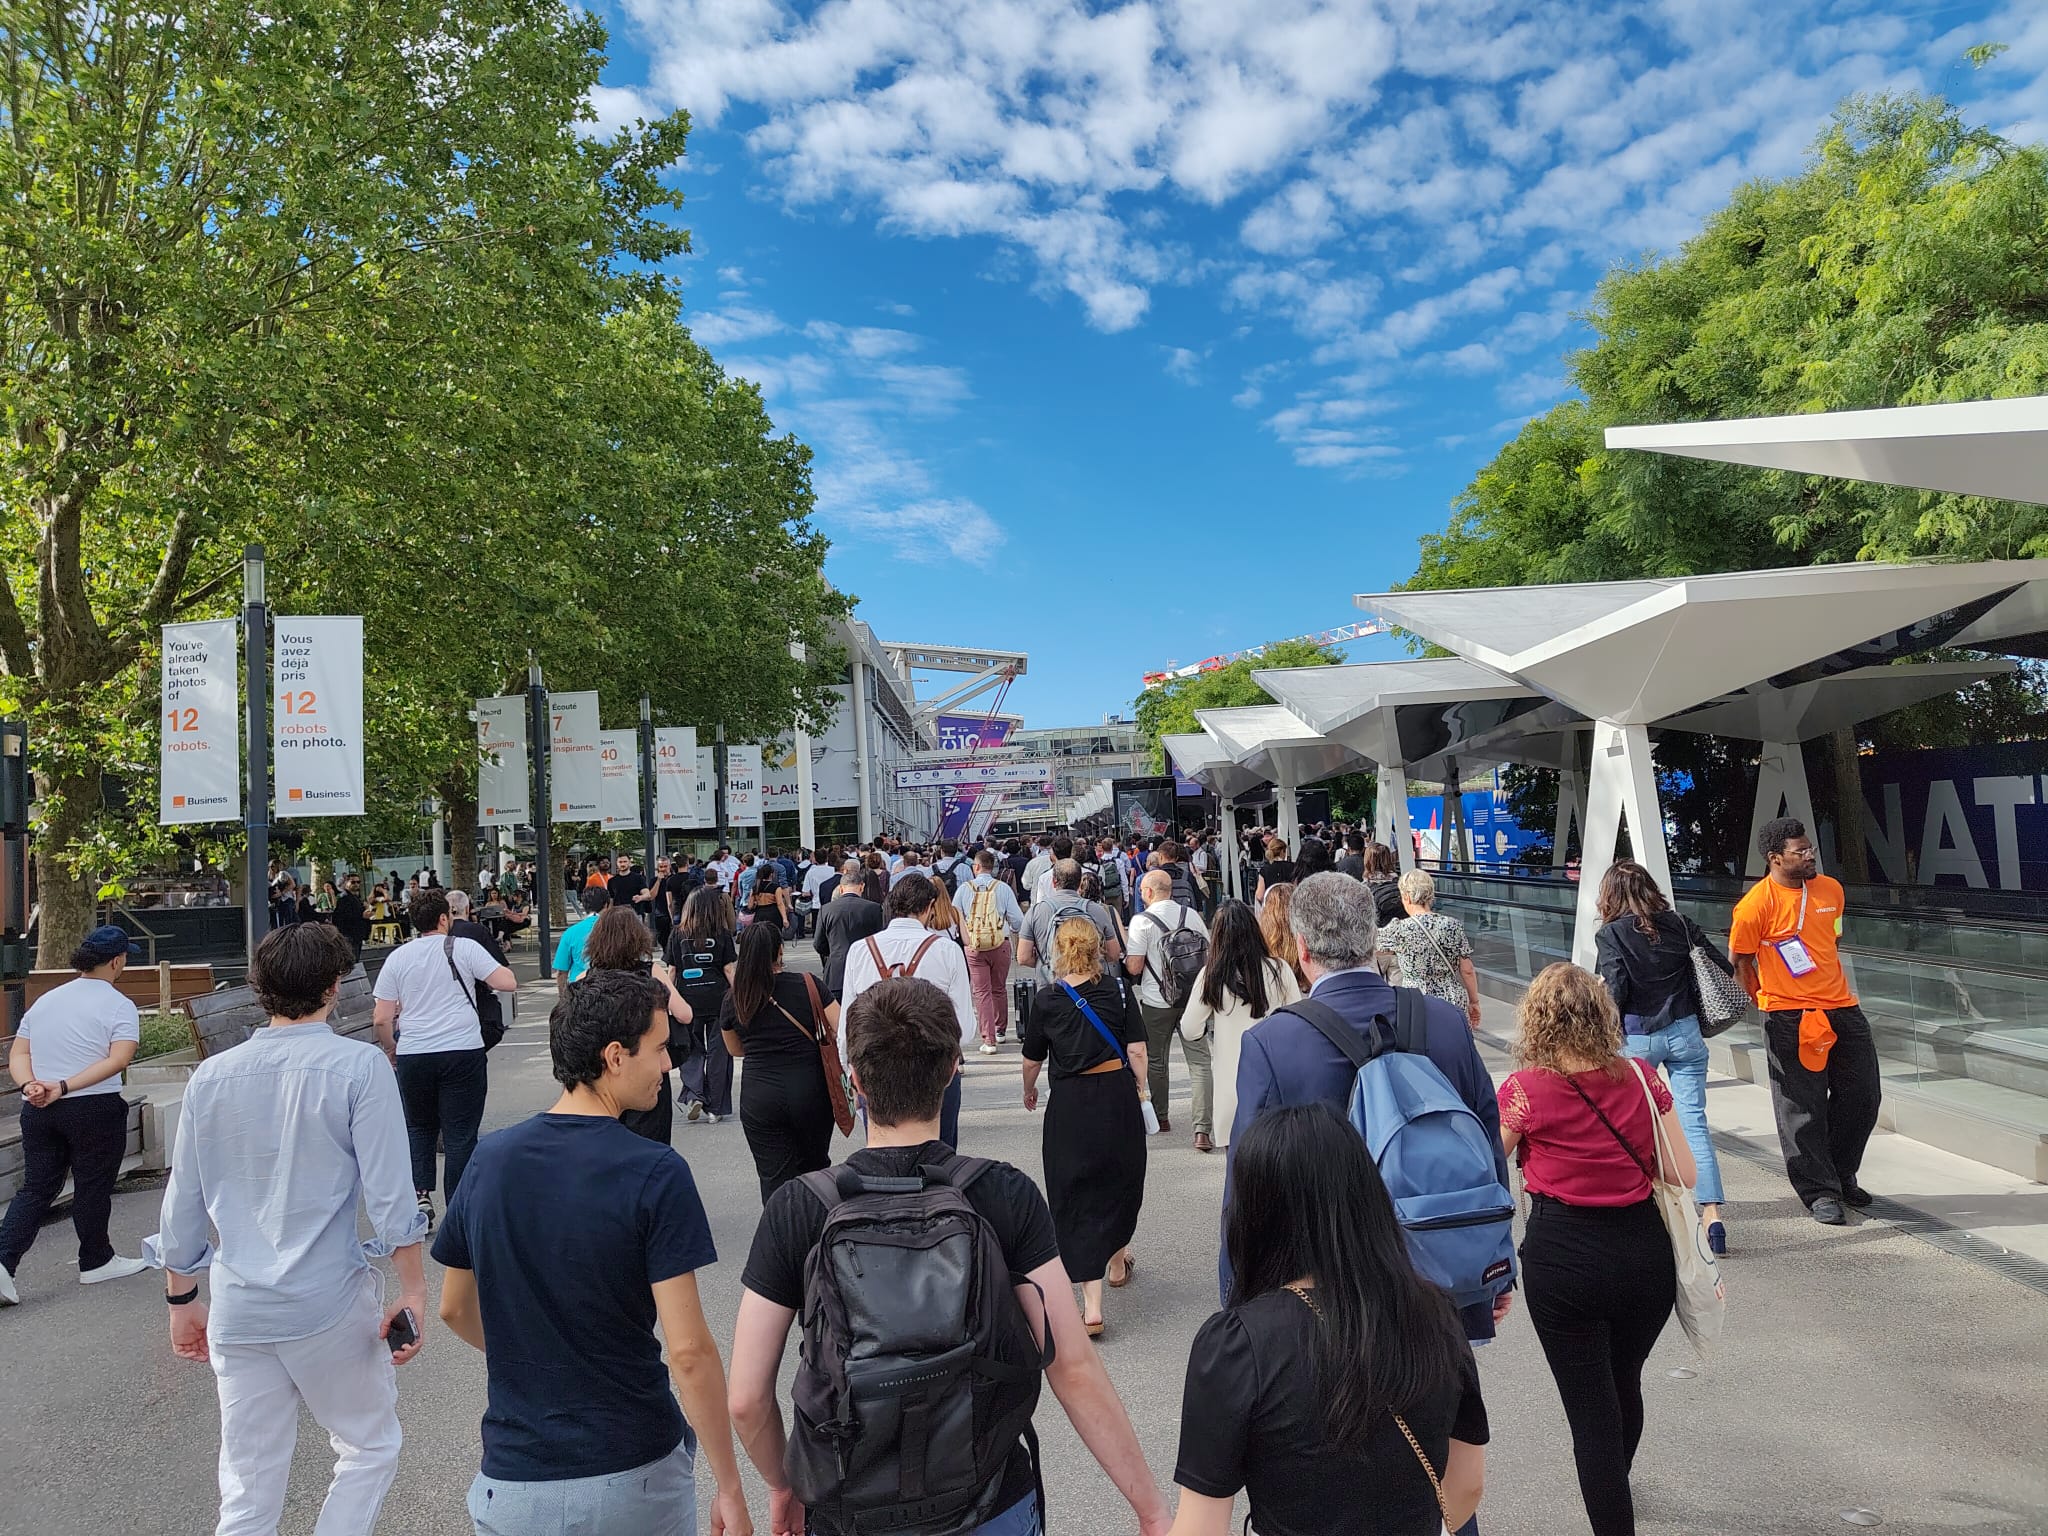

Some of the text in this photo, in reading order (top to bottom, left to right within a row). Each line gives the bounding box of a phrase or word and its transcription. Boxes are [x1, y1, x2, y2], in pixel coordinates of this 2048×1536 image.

[281, 634, 313, 645] Vous
[168, 640, 204, 652] You've
[281, 648, 311, 656] avez
[168, 652, 208, 664] already
[281, 658, 309, 670] déjà
[168, 666, 199, 676] taken
[281, 671, 306, 682] pris
[168, 677, 207, 690] photos
[168, 691, 180, 701] of
[280, 691, 317, 715] 12
[552, 702, 577, 711] Écouté
[167, 707, 199, 732] 12
[552, 715, 563, 731] 7
[280, 723, 328, 735] robots
[480, 721, 490, 737] 7
[280, 737, 346, 750] en photo.
[553, 736, 573, 744] talks
[168, 741, 211, 752] robots.
[553, 744, 596, 754] inspirants.
[658, 745, 677, 758] 40
[601, 748, 618, 761] 40
[730, 780, 753, 791] Hall
[305, 790, 351, 800] Business
[731, 793, 748, 804] 7.2
[187, 796, 228, 806] Business
[495, 807, 522, 815] Business
[569, 803, 597, 811] Business
